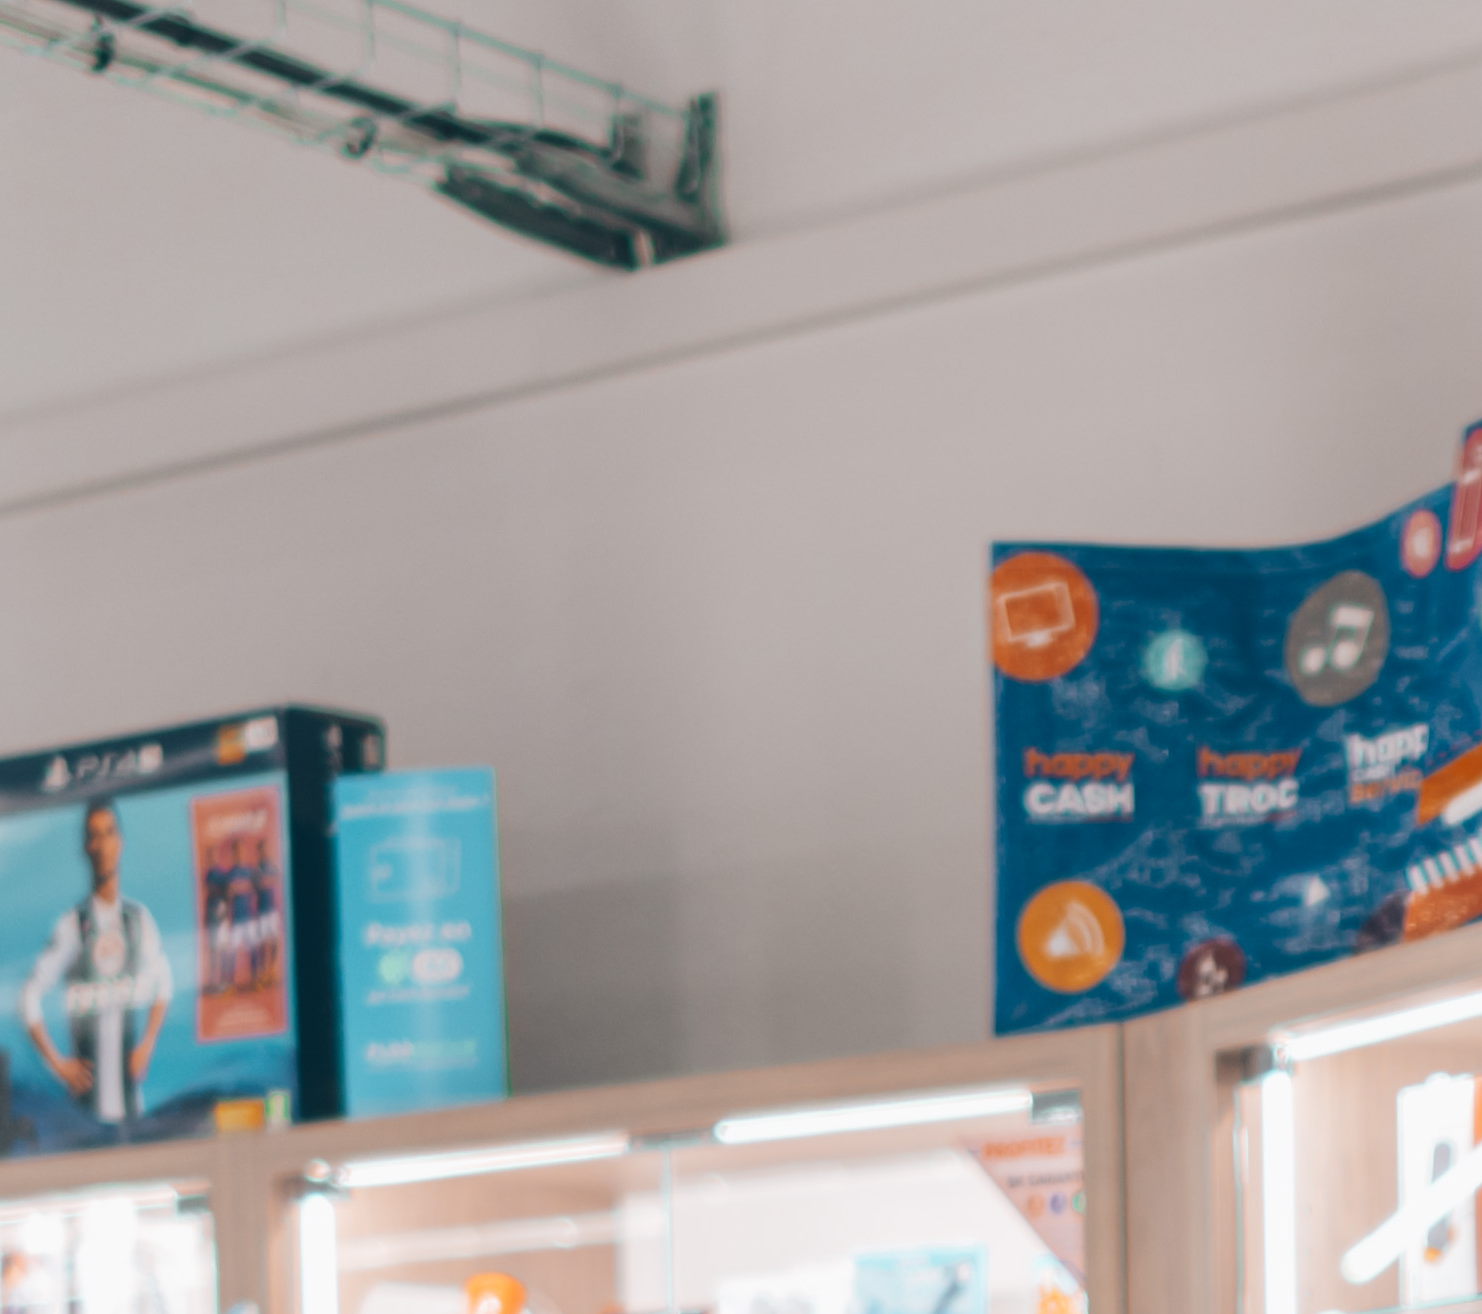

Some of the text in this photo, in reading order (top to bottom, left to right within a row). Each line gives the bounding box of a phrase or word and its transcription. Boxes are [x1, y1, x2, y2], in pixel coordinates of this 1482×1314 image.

[1025, 748, 1135, 782] happy
[1197, 747, 1301, 782] happy
[1025, 780, 1135, 814] CASH
[1198, 779, 1299, 815] TROC
